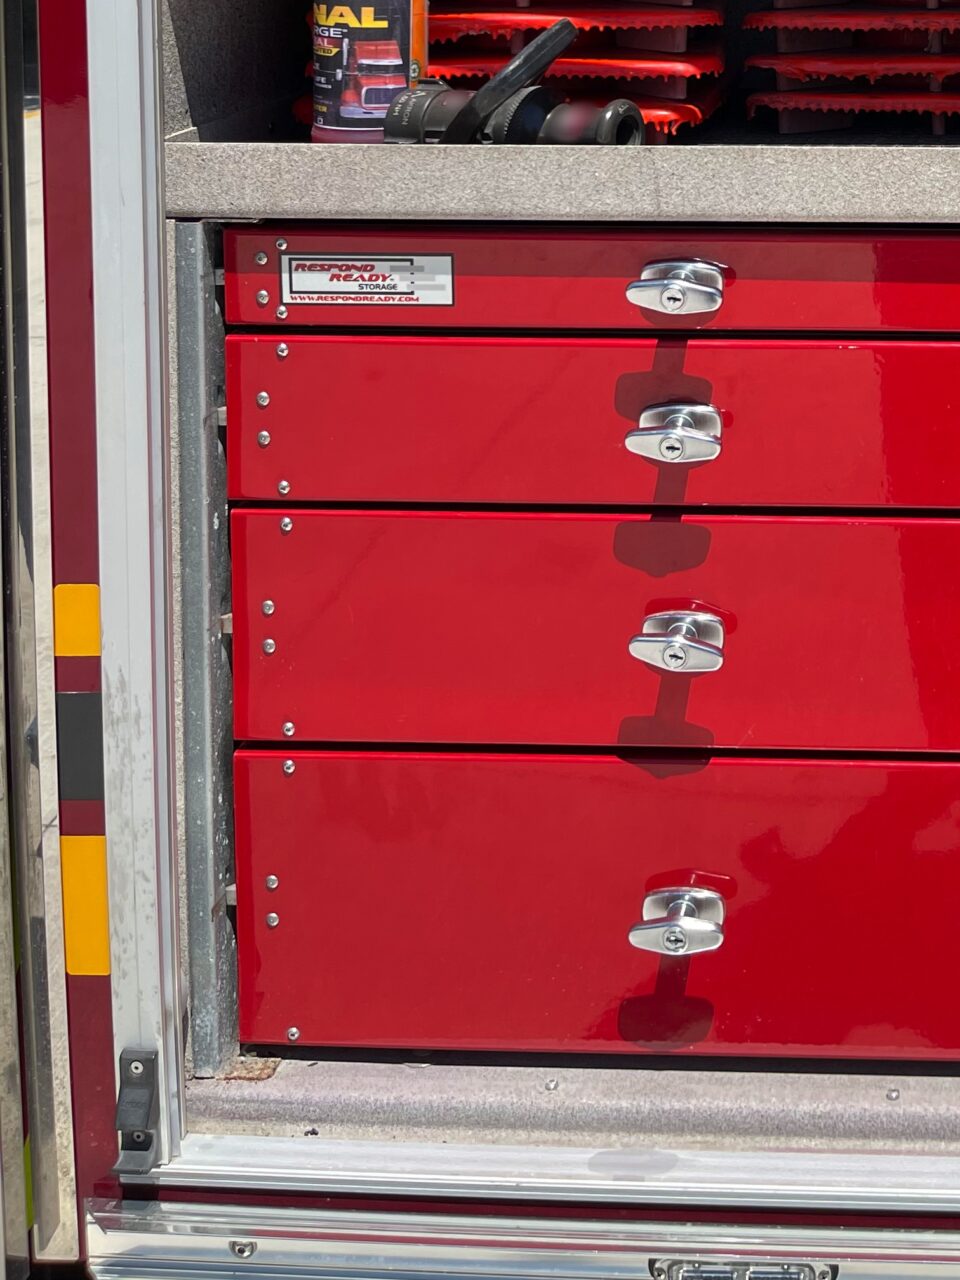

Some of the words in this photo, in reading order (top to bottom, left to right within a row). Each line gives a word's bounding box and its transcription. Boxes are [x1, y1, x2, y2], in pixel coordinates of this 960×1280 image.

[294, 263, 376, 273] RESPOND
[329, 273, 392, 282] READY
[358, 283, 398, 291] STORAGE
[290, 295, 420, 303] WWW.RESPONDREADY.COM
